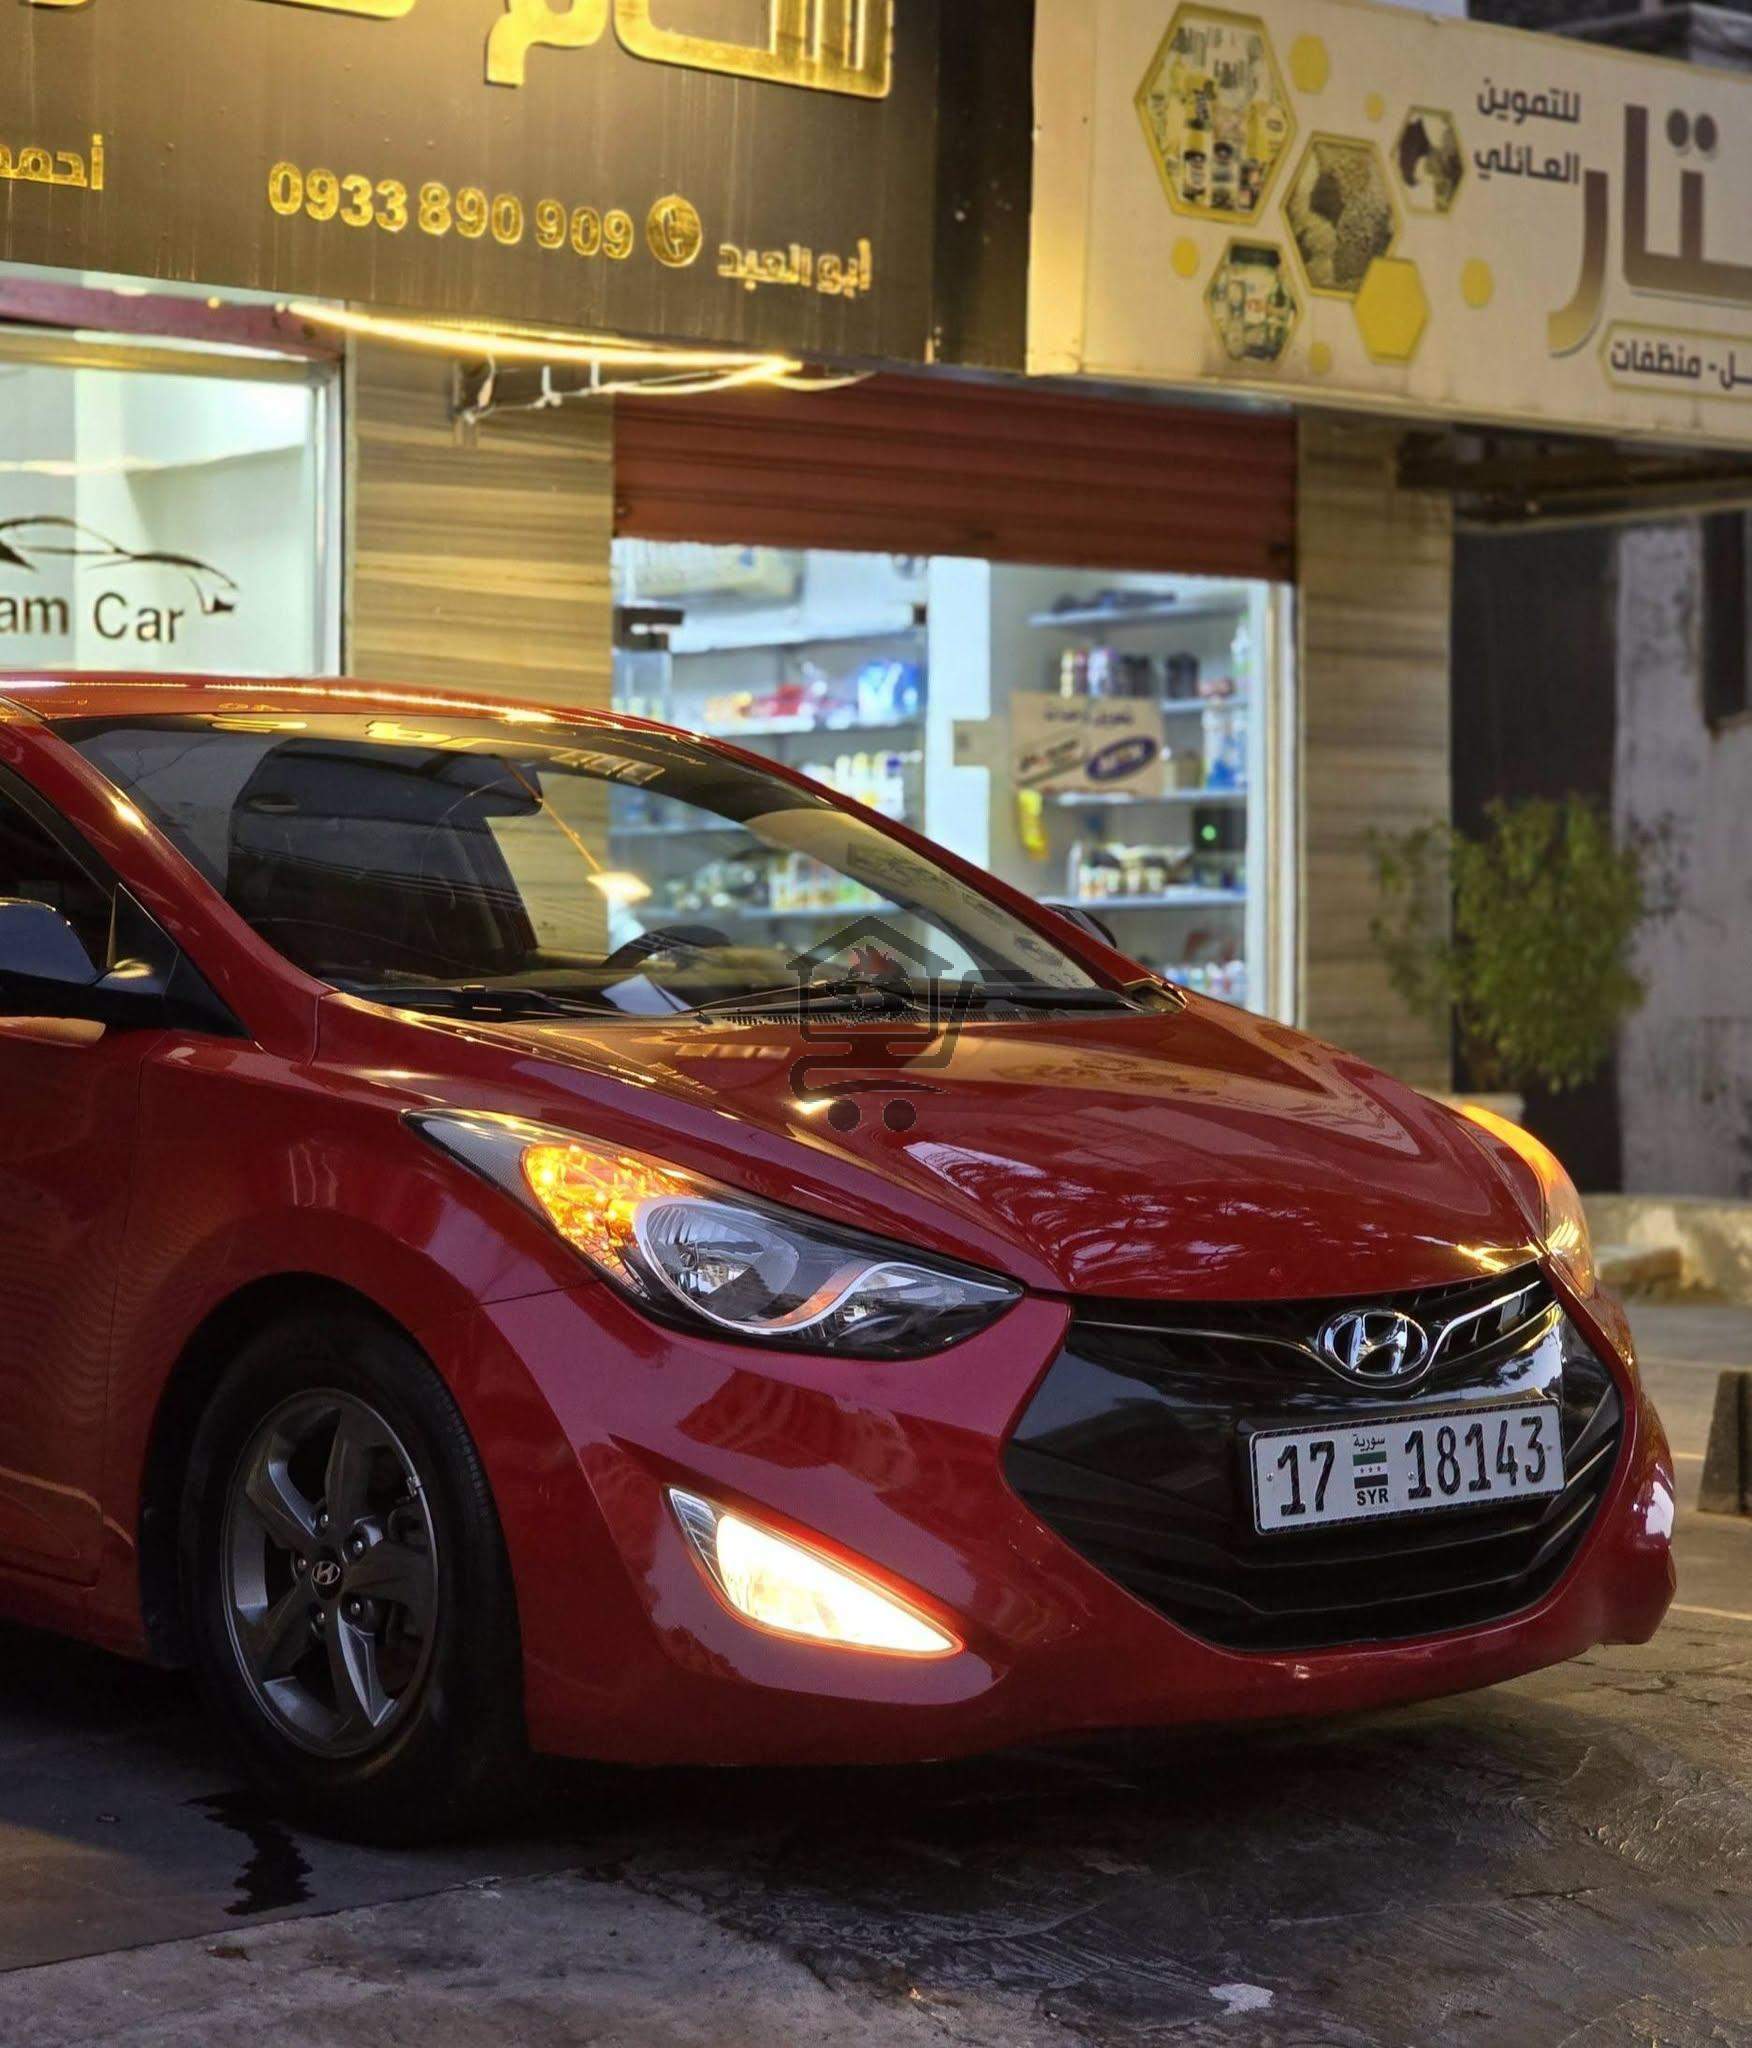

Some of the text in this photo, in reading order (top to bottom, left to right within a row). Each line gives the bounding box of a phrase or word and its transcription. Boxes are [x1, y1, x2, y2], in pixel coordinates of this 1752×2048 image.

[1477, 77, 1580, 125] للتموين
[1474, 142, 1580, 184] العائلي
[268, 161, 635, 260] 0933 890 909
[1546, 103, 1752, 349] تار
[1611, 340, 1702, 379] منظفات
[93, 591, 184, 643] Car
[1277, 1415, 1546, 1516] 17 18143
[1353, 1433, 1386, 1452] سورية
[1356, 1487, 1389, 1506] SYR
